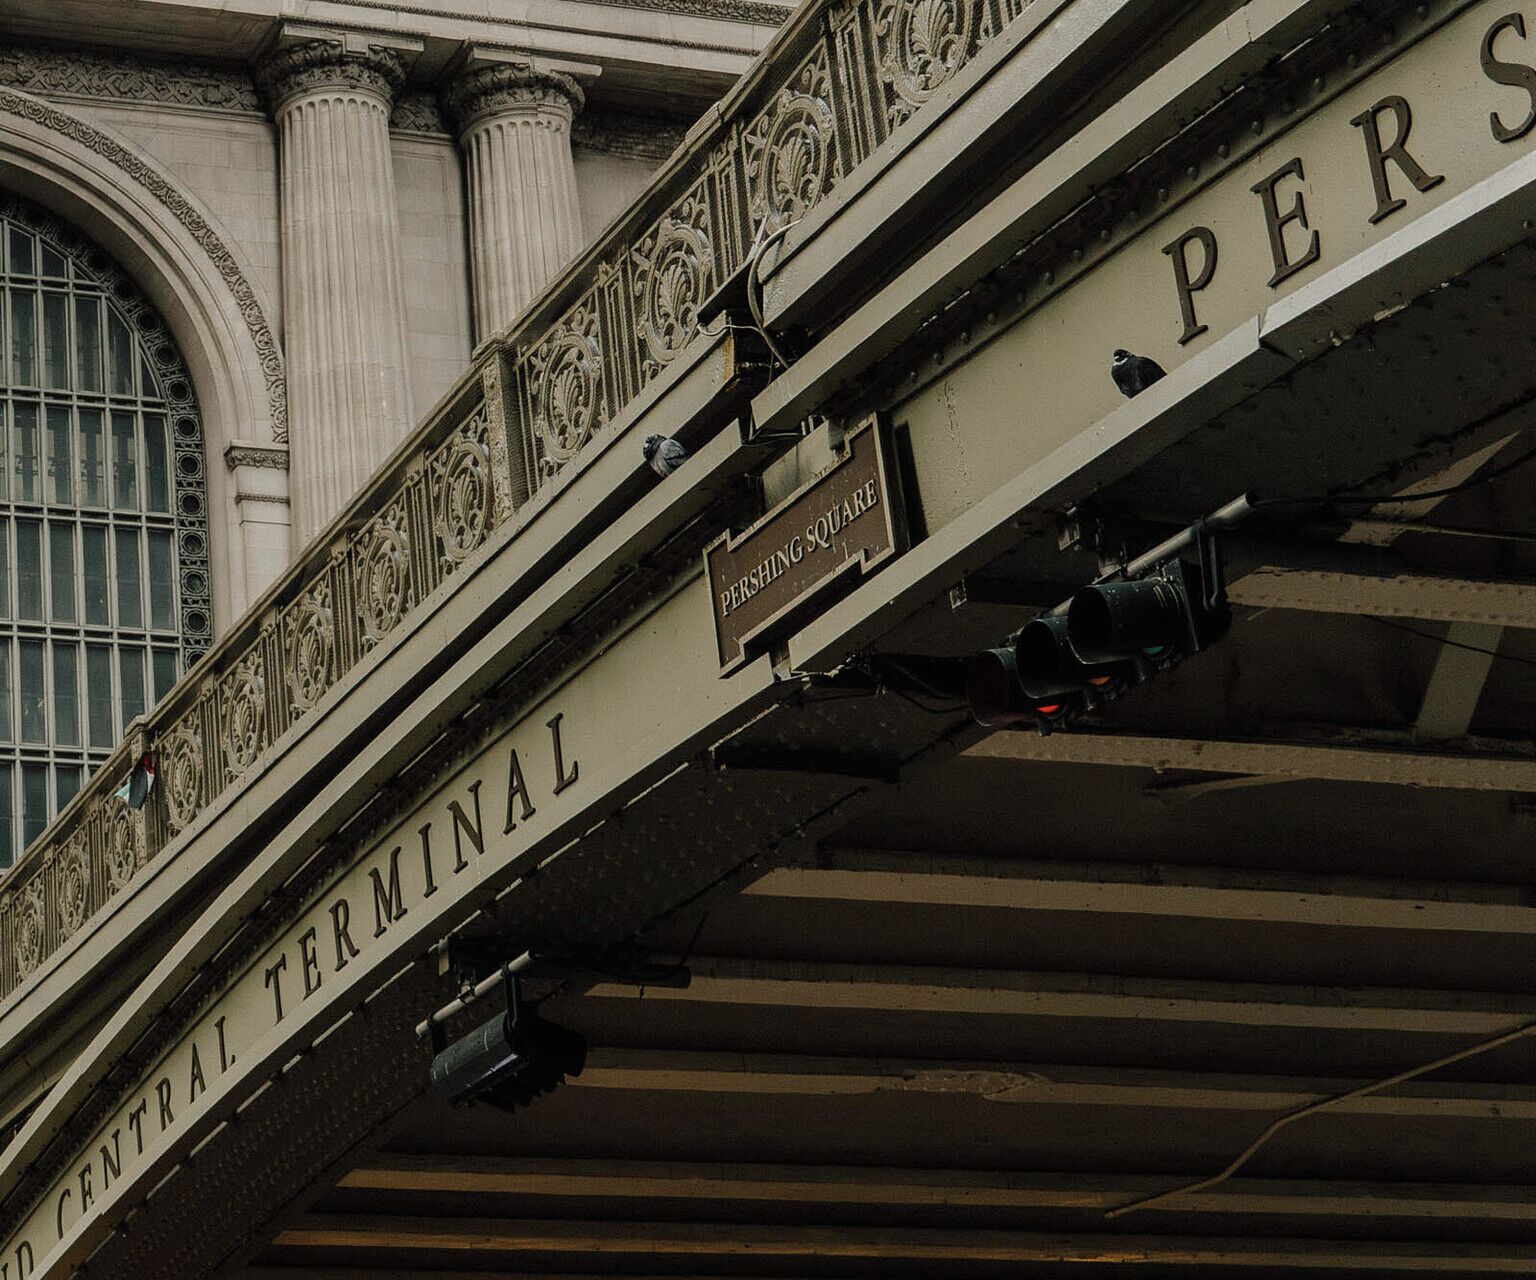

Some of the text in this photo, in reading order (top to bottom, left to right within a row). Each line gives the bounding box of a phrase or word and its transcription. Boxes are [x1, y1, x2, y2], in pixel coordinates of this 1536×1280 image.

[1159, 11, 1536, 348] PERS
[718, 477, 880, 620] PERSHING SQUARE
[54, 1014, 238, 1242] CENTRAL
[262, 710, 581, 1027] TERMINAL
